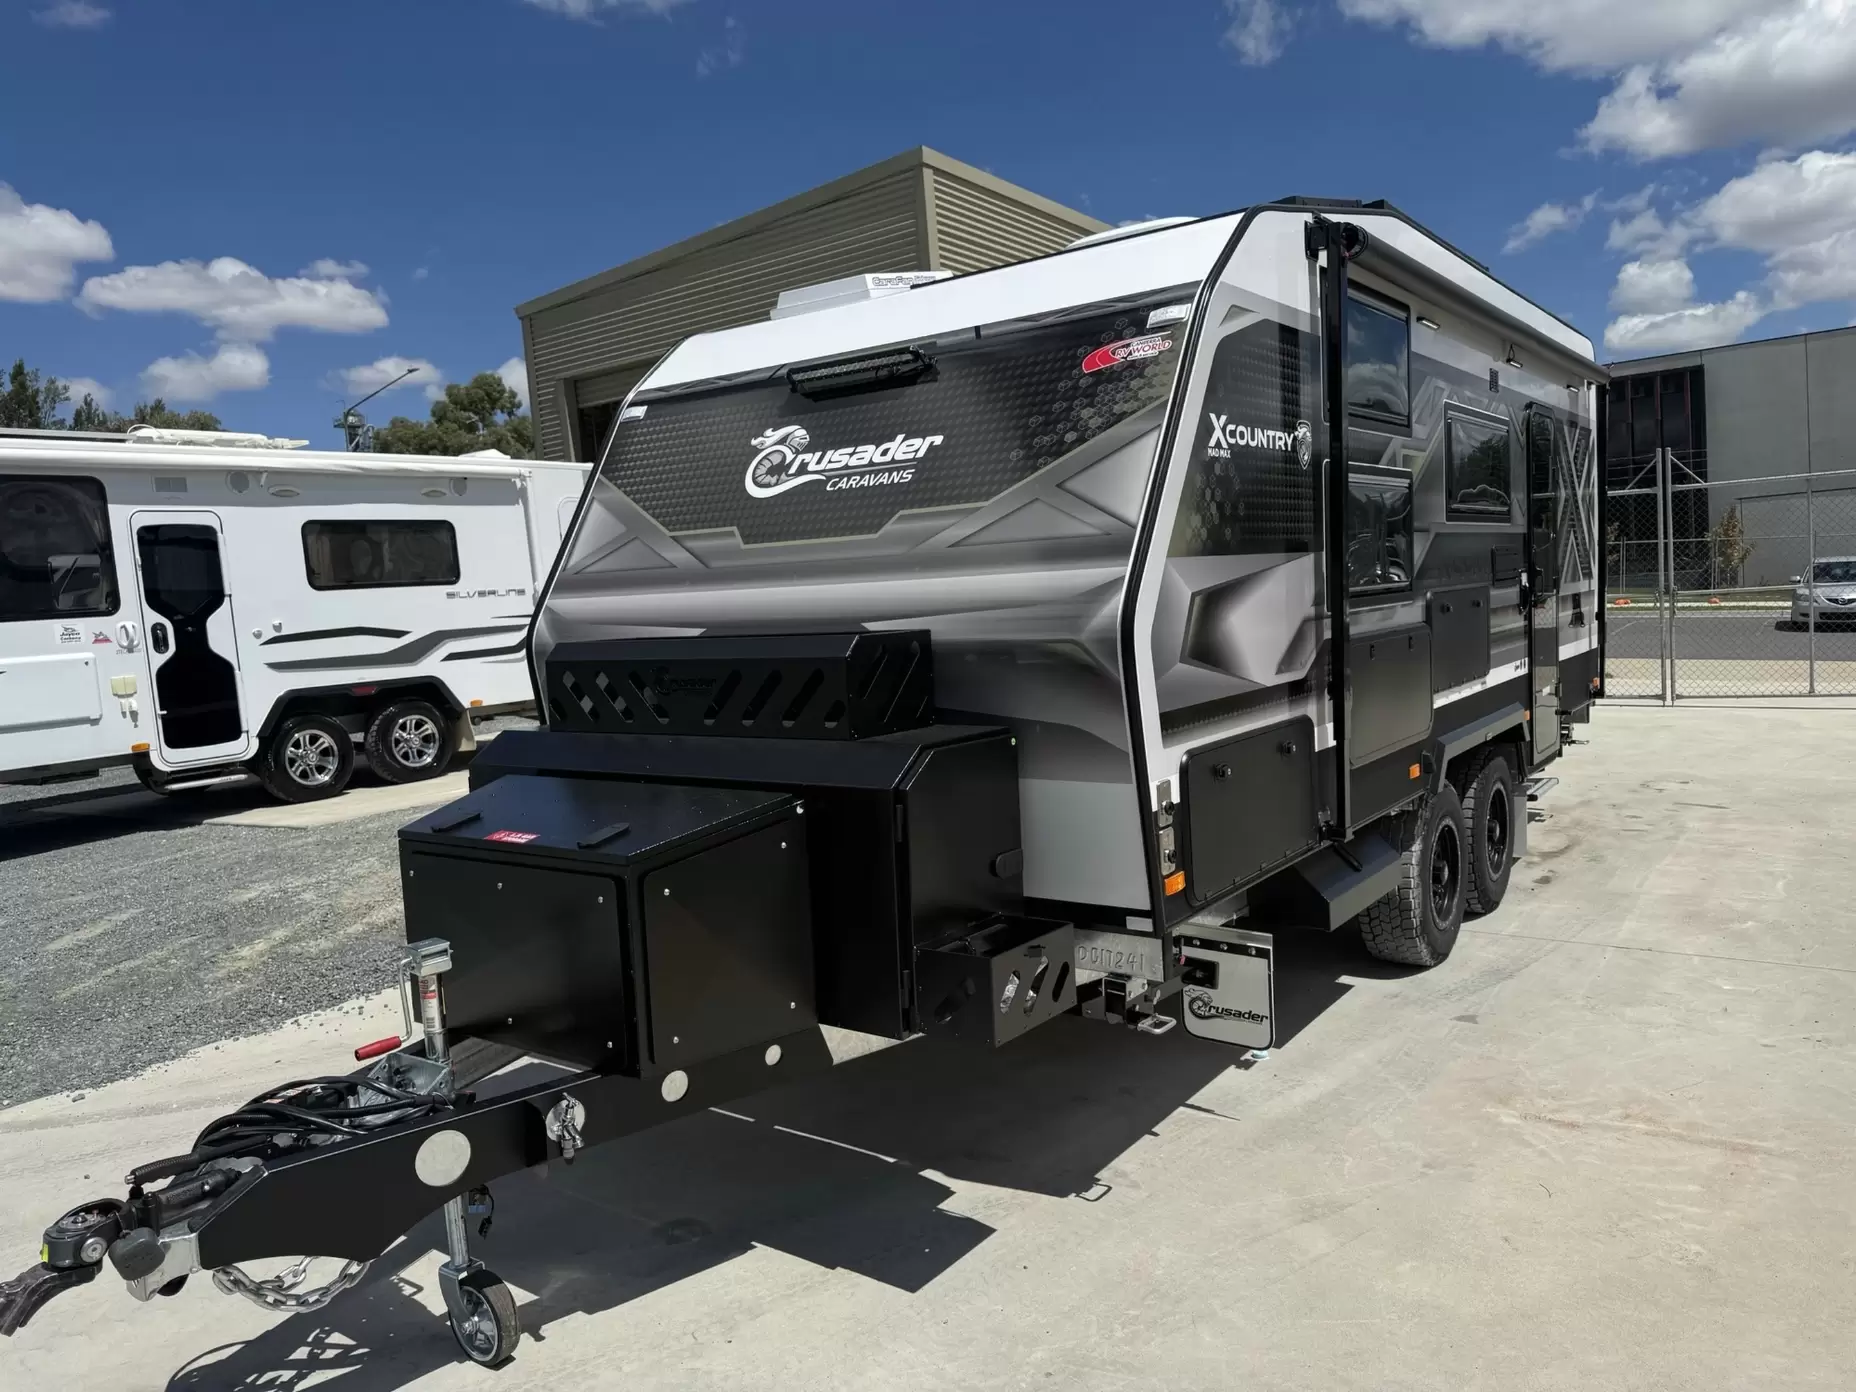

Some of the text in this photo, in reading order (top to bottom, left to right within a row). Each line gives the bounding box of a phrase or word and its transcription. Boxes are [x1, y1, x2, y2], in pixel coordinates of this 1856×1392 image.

[1115, 347, 1130, 358] RV
[1131, 340, 1171, 354] WORLD
[1207, 447, 1231, 458] MAD MAX
[745, 434, 944, 499] Crusader
[826, 469, 915, 491] CARAVANS
[1189, 998, 1268, 1023] Crusader
